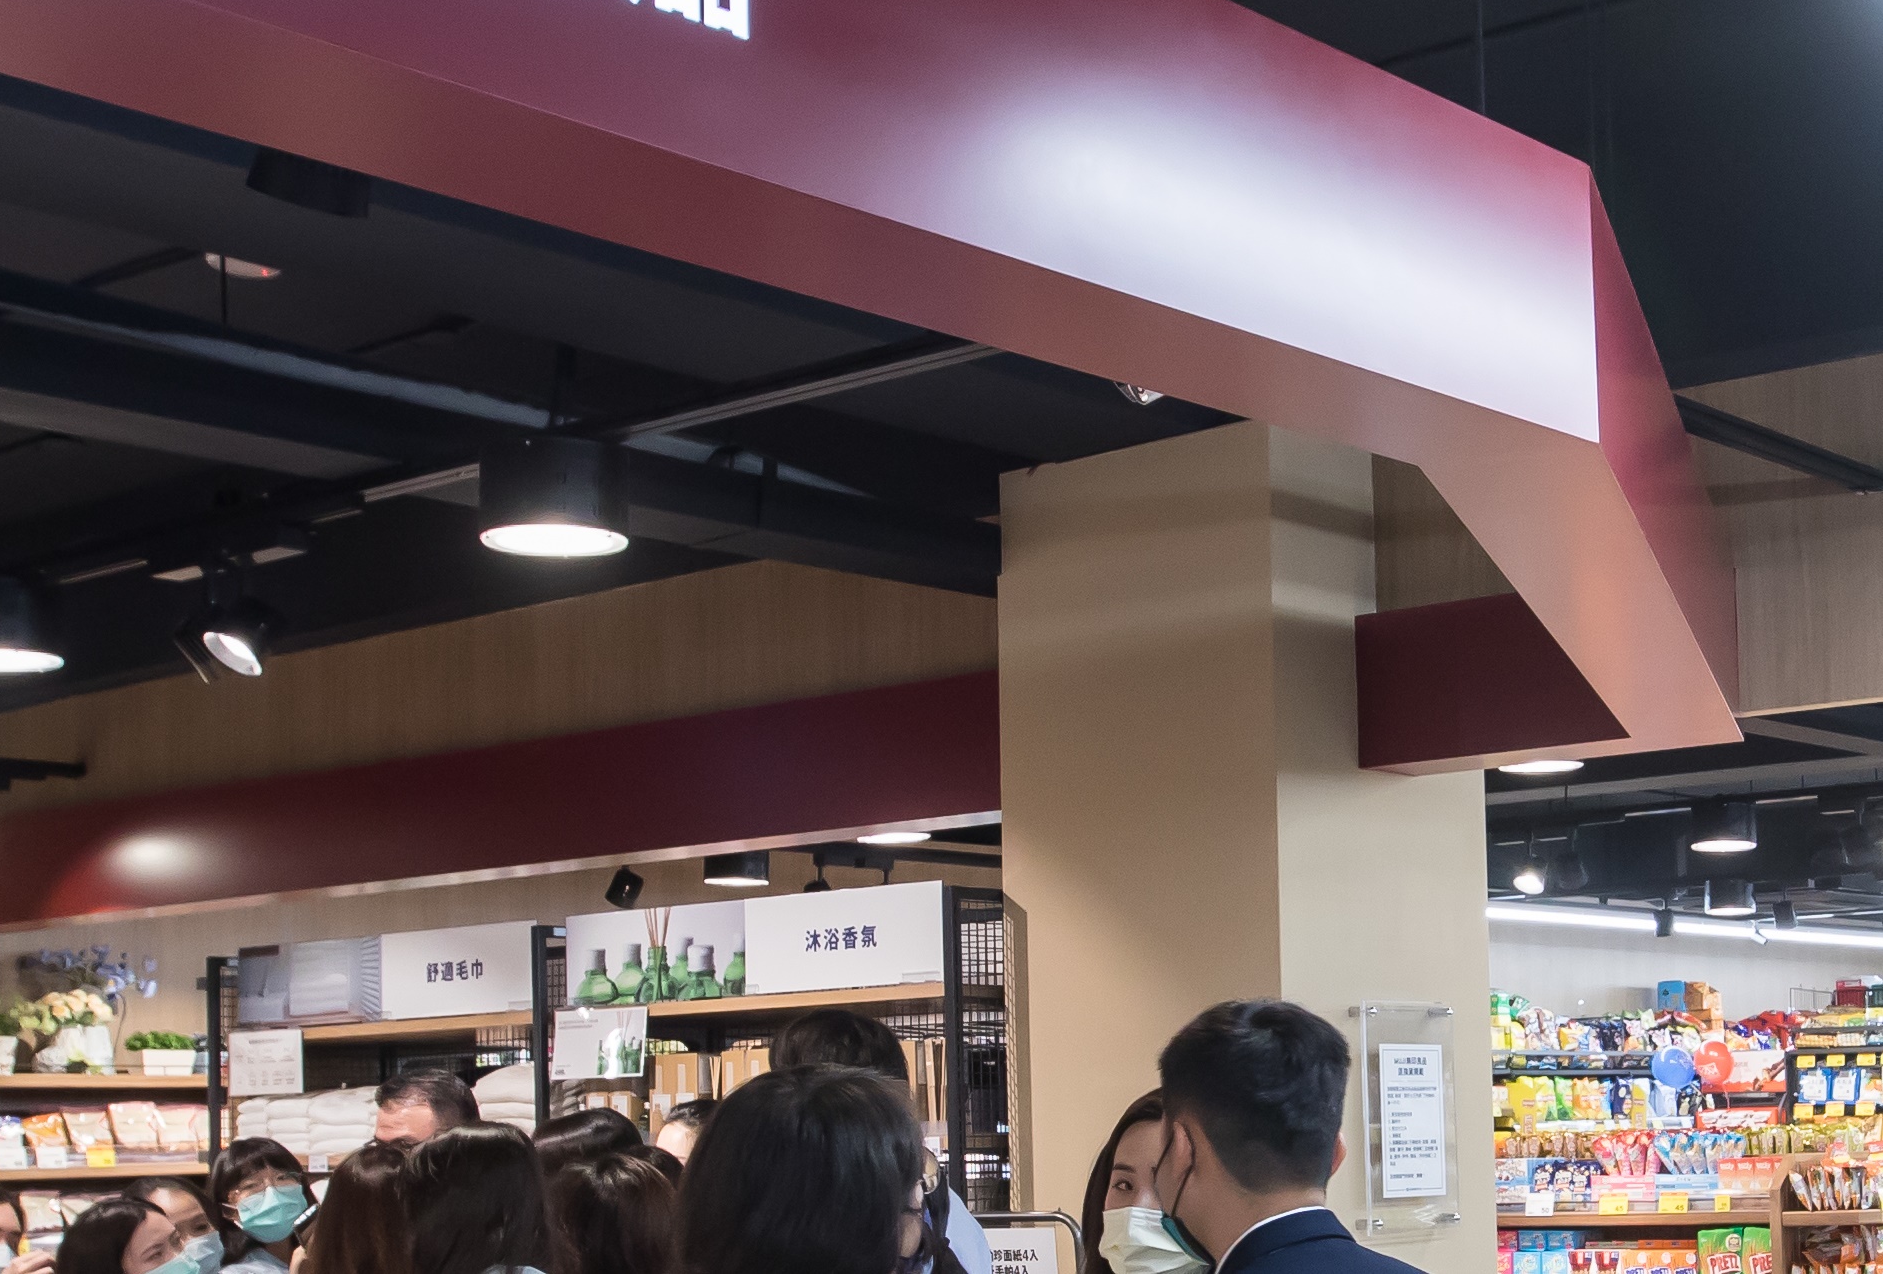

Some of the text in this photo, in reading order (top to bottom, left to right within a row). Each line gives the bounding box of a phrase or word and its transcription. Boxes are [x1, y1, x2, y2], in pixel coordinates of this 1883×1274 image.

[805, 925, 877, 952] 沐浴香氛
[426, 958, 484, 983] 舒適毛巾
[990, 1249, 1039, 1262] 珍面紙4入
[1752, 1253, 1772, 1273] PRE
[991, 1265, 1029, 1274] 手帕4入
